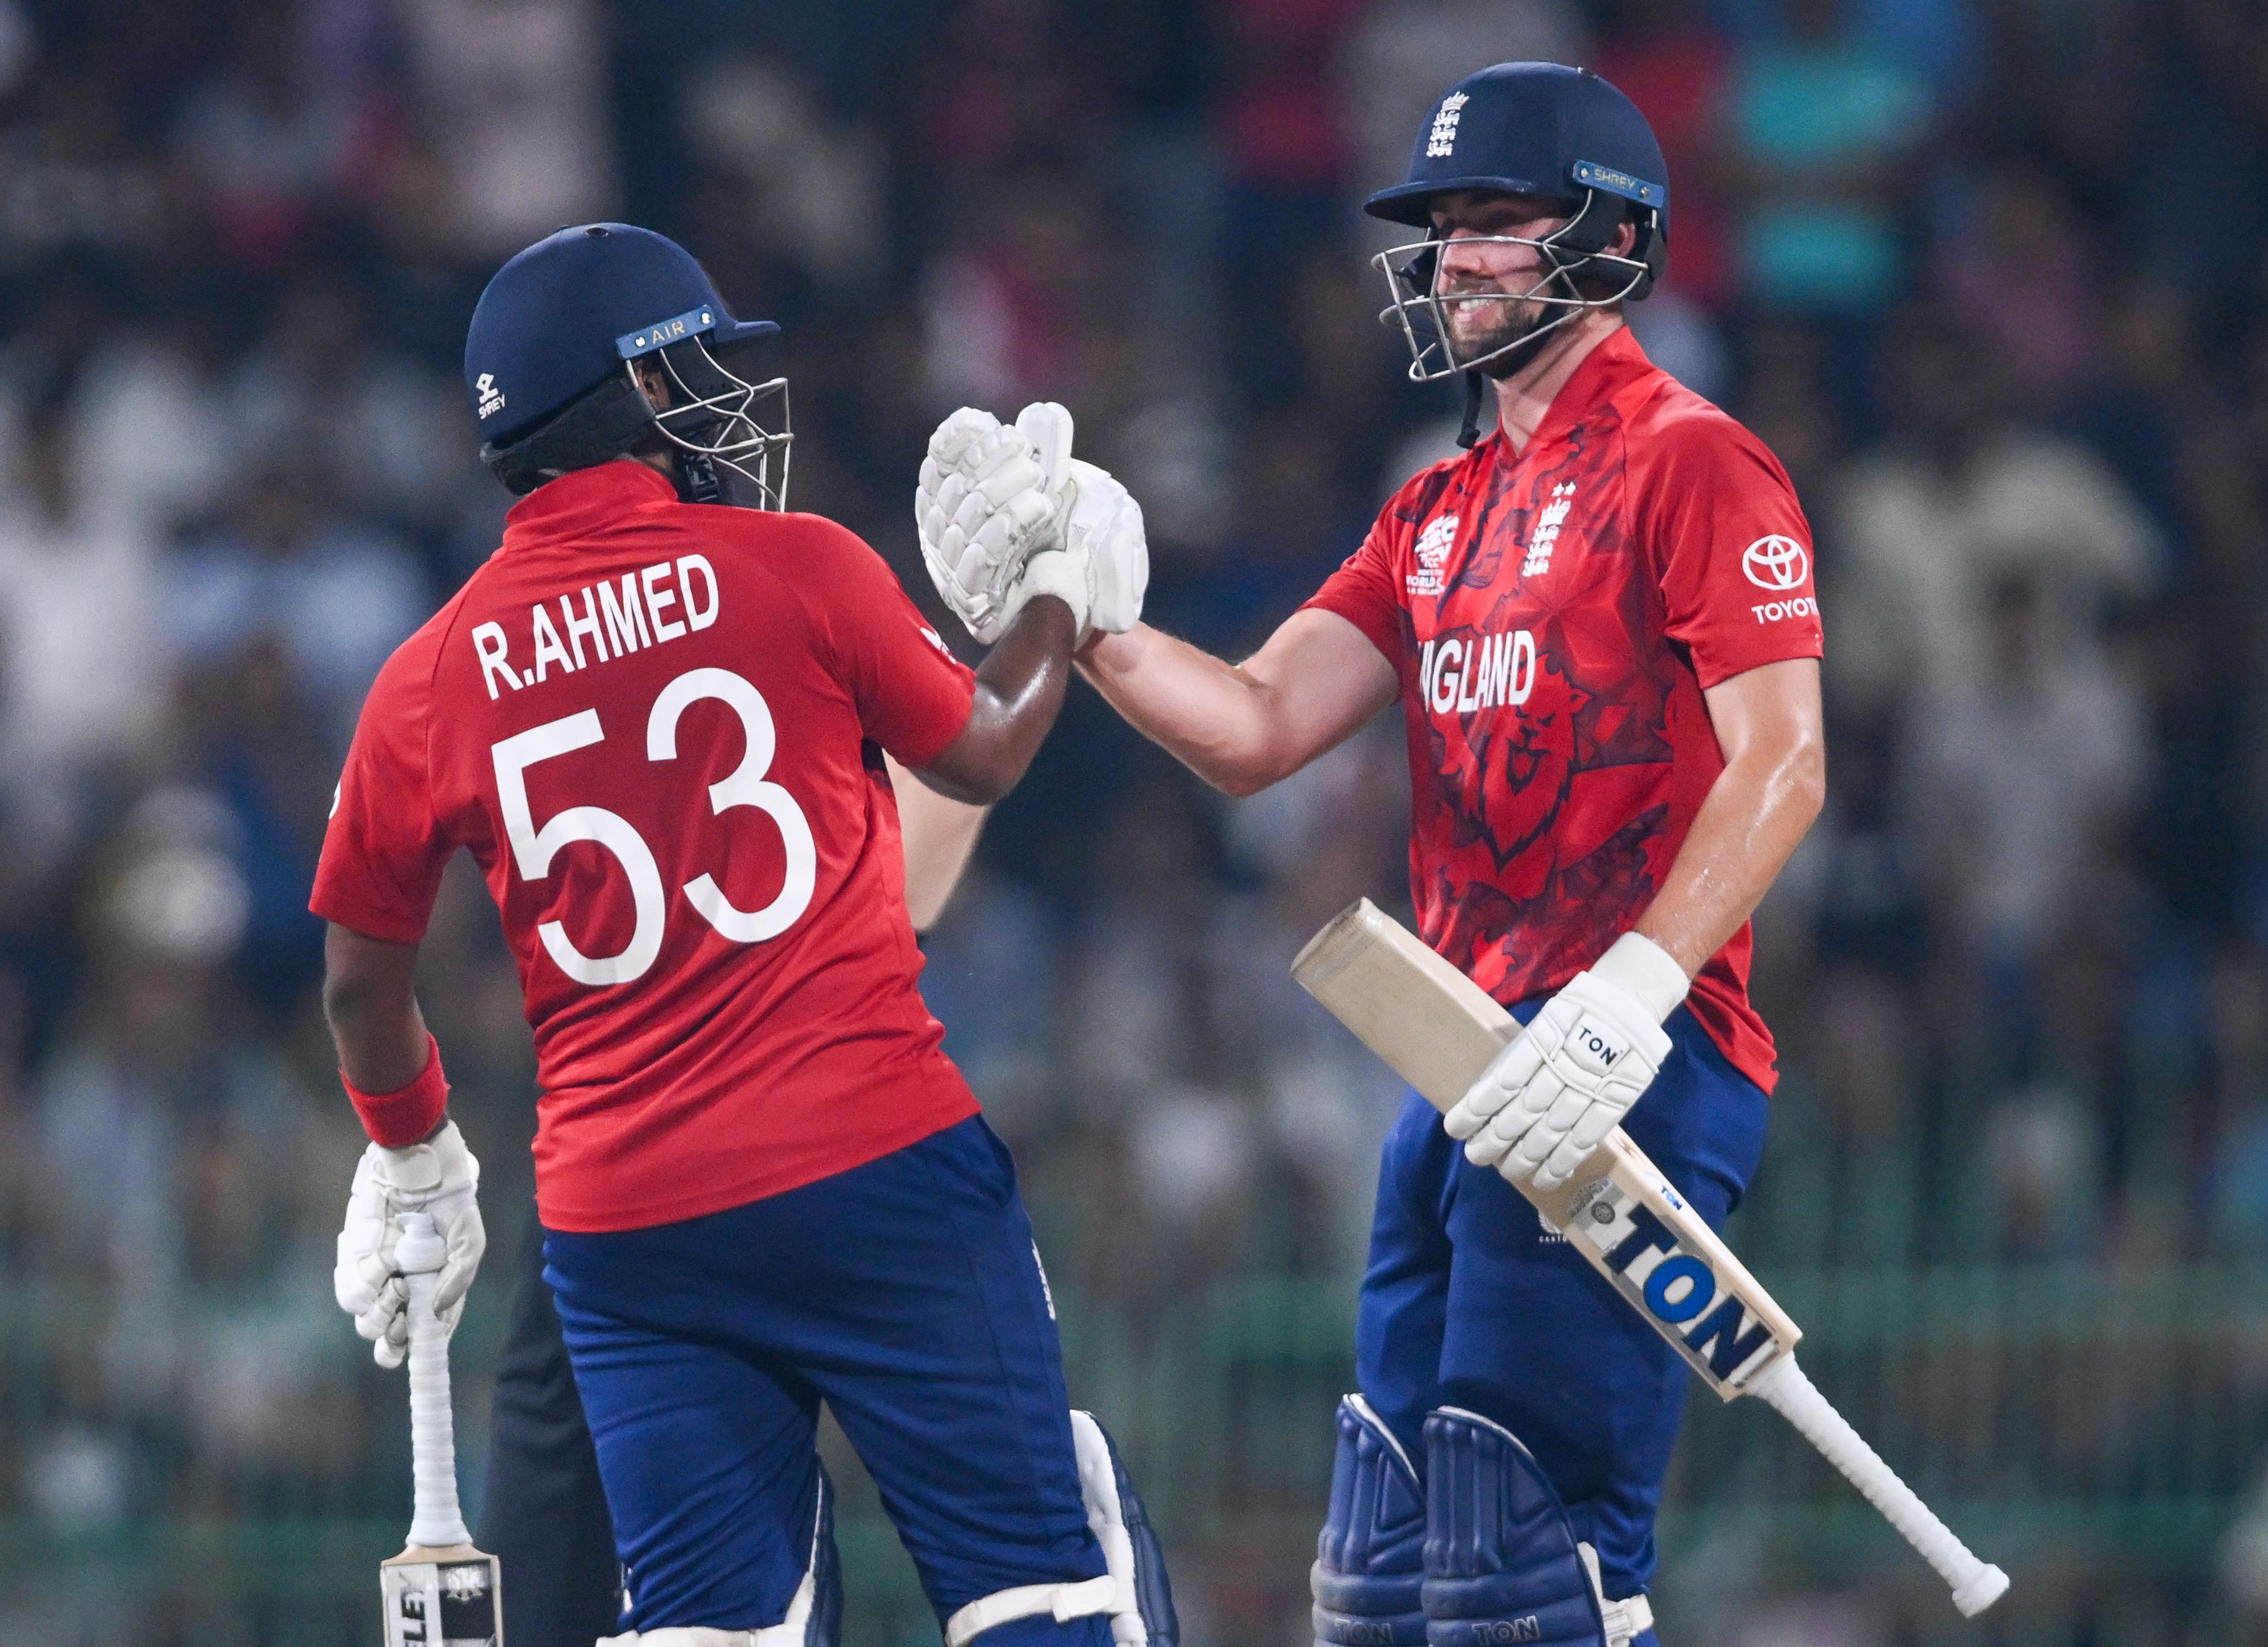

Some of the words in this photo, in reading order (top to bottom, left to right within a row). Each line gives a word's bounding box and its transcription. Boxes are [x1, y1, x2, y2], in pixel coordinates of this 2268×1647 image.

[1594, 167, 1635, 190] SHREY
[652, 320, 685, 344] AIR
[478, 393, 505, 420] SHREY
[471, 554, 719, 700] R.AHMED
[1418, 629, 1536, 714] NGLAND
[491, 667, 817, 986] 53
[1578, 1025, 1618, 1065] TON
[1661, 1185, 1683, 1210] TON
[1602, 1201, 1773, 1382] TON
[1471, 1615, 1540, 1645] TON
